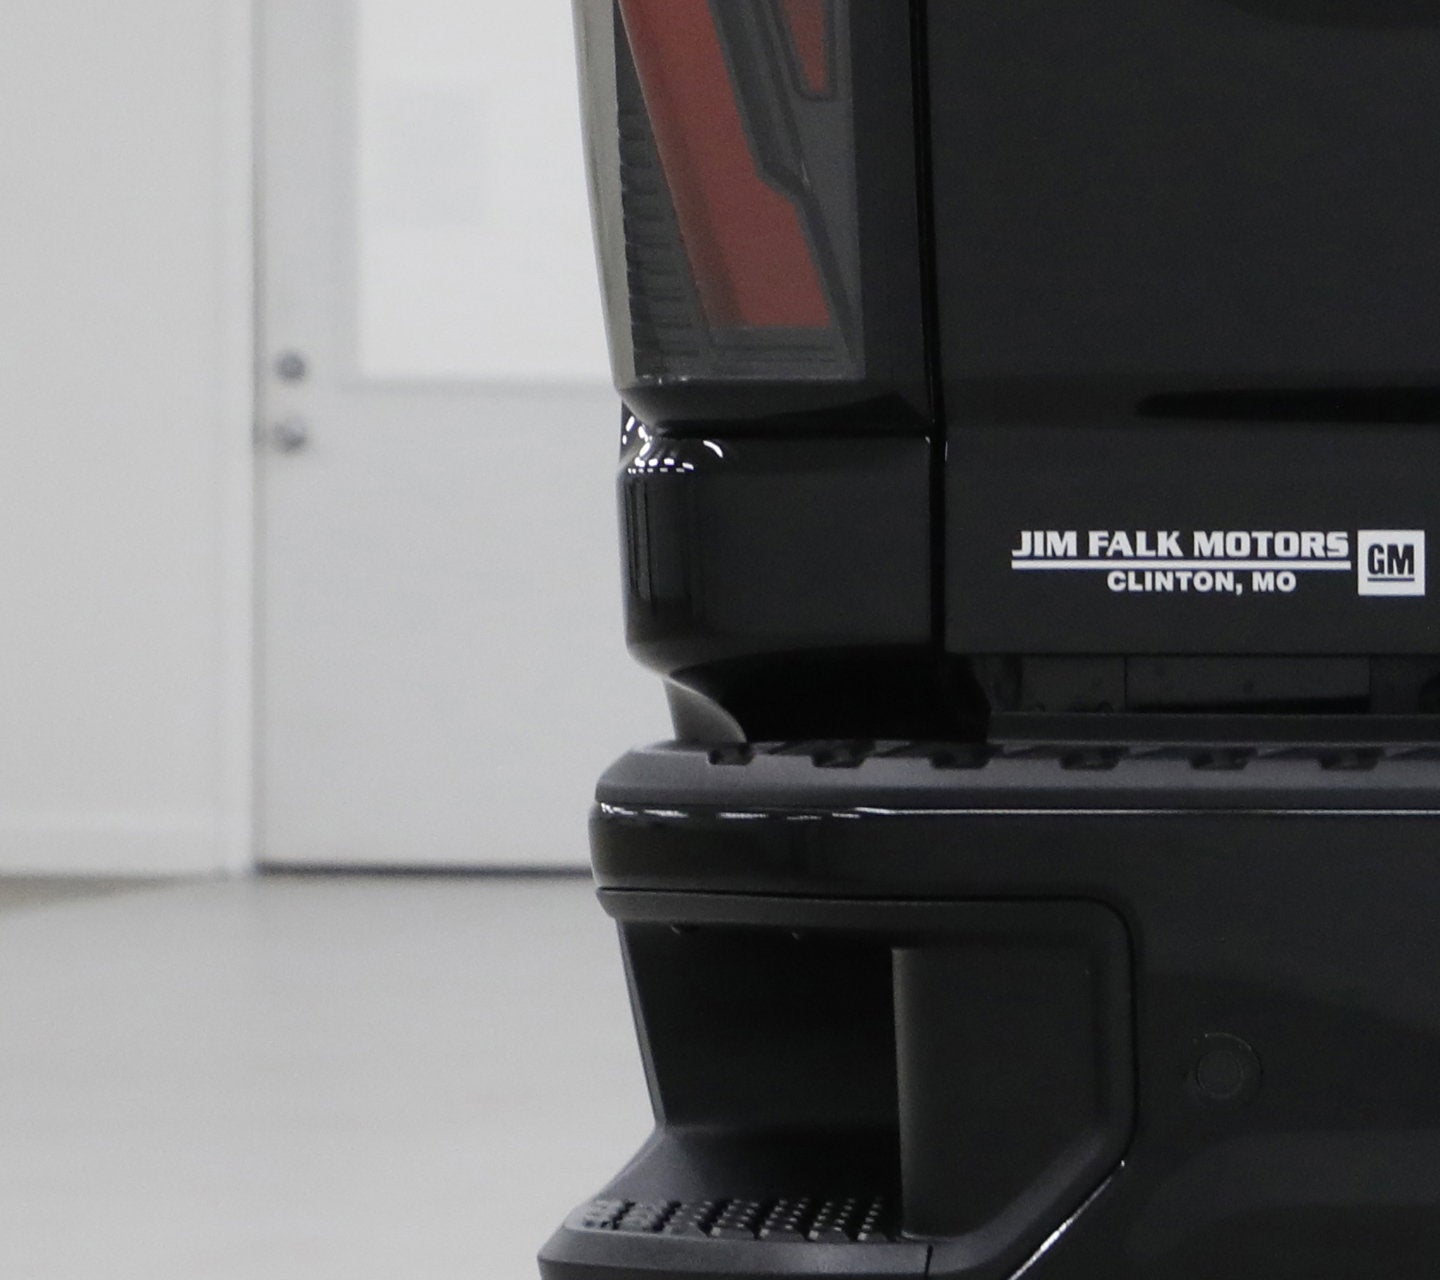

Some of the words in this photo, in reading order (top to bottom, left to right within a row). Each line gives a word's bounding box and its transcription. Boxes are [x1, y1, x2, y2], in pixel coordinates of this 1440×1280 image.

[1011, 530, 1078, 558] JIM
[1087, 530, 1184, 559] FALK
[1193, 530, 1349, 559] MOTORS
[1367, 543, 1416, 576] GM
[1106, 570, 1244, 596] CLINTON,
[1251, 570, 1297, 593] MO
